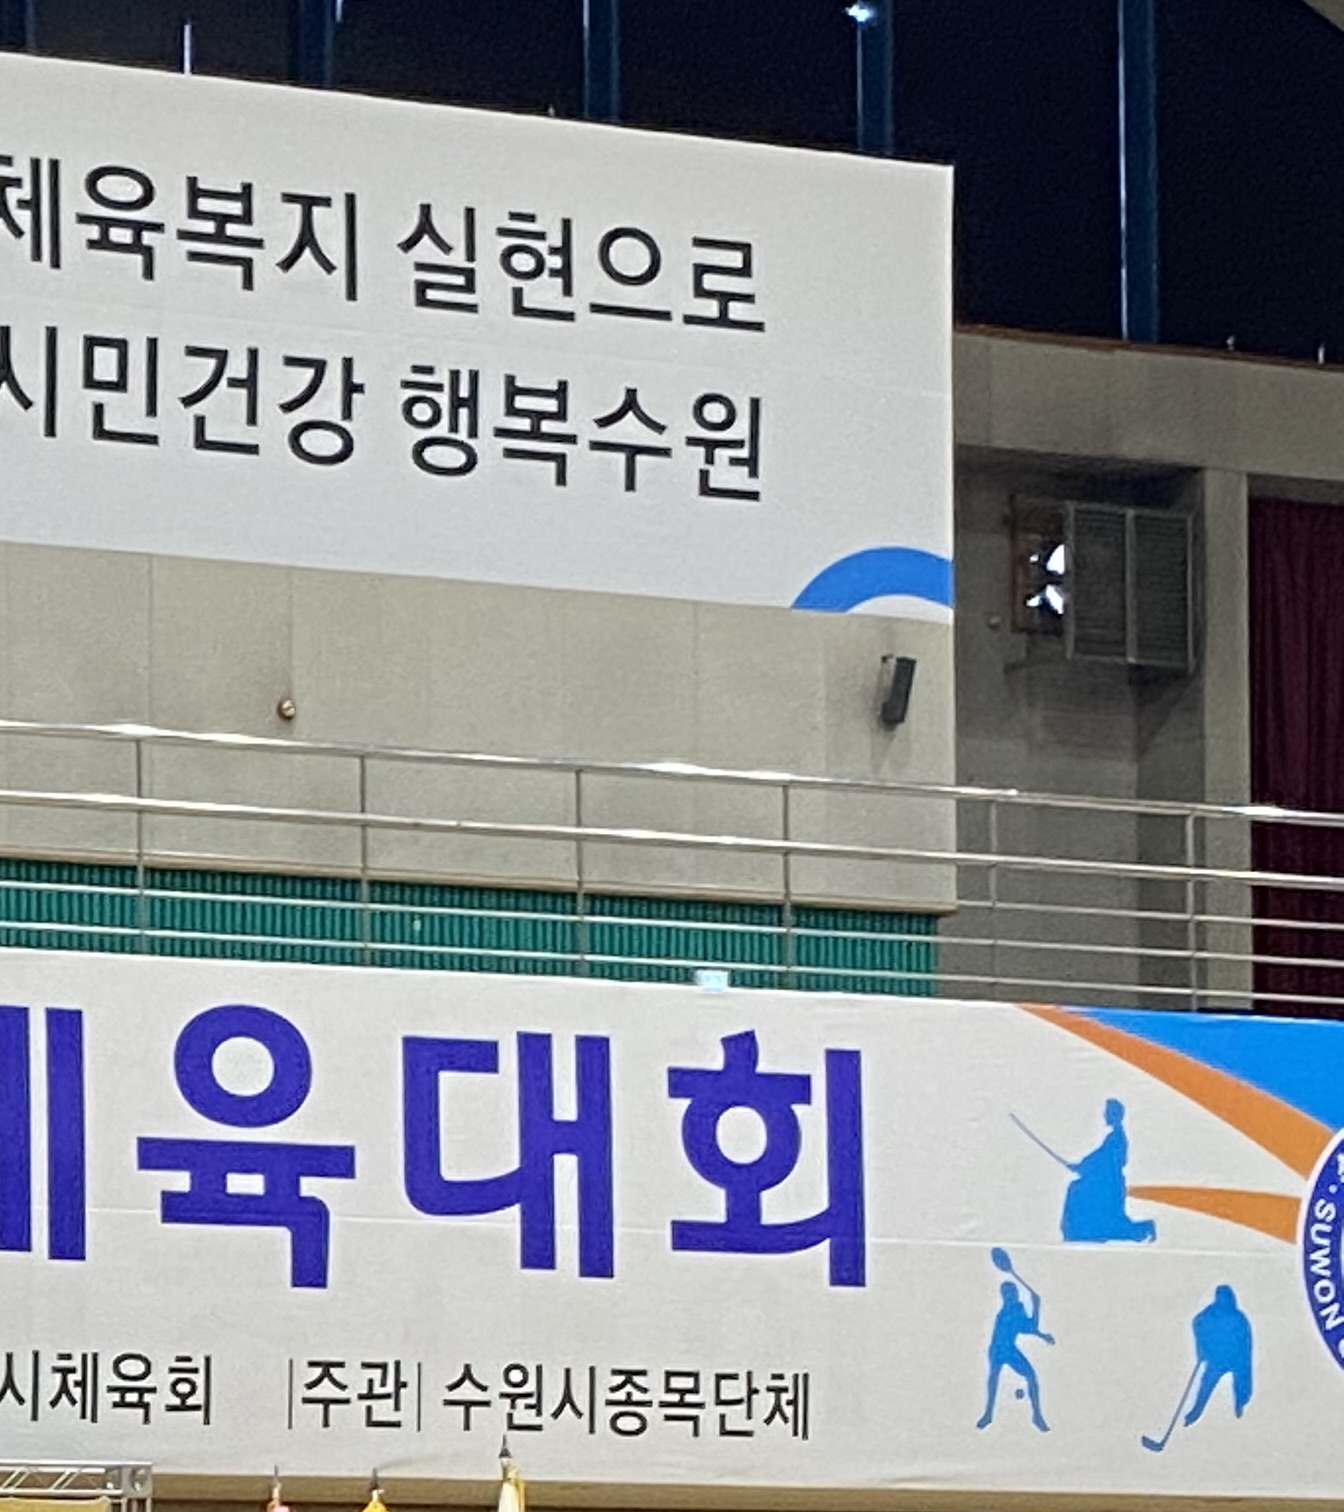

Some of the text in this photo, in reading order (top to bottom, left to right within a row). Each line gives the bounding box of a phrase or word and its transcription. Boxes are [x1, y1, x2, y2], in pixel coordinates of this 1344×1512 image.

[397, 203, 765, 333] 실현으로
[400, 364, 761, 502] 행복수원
[443, 1363, 809, 1440] 수원시종목단체
